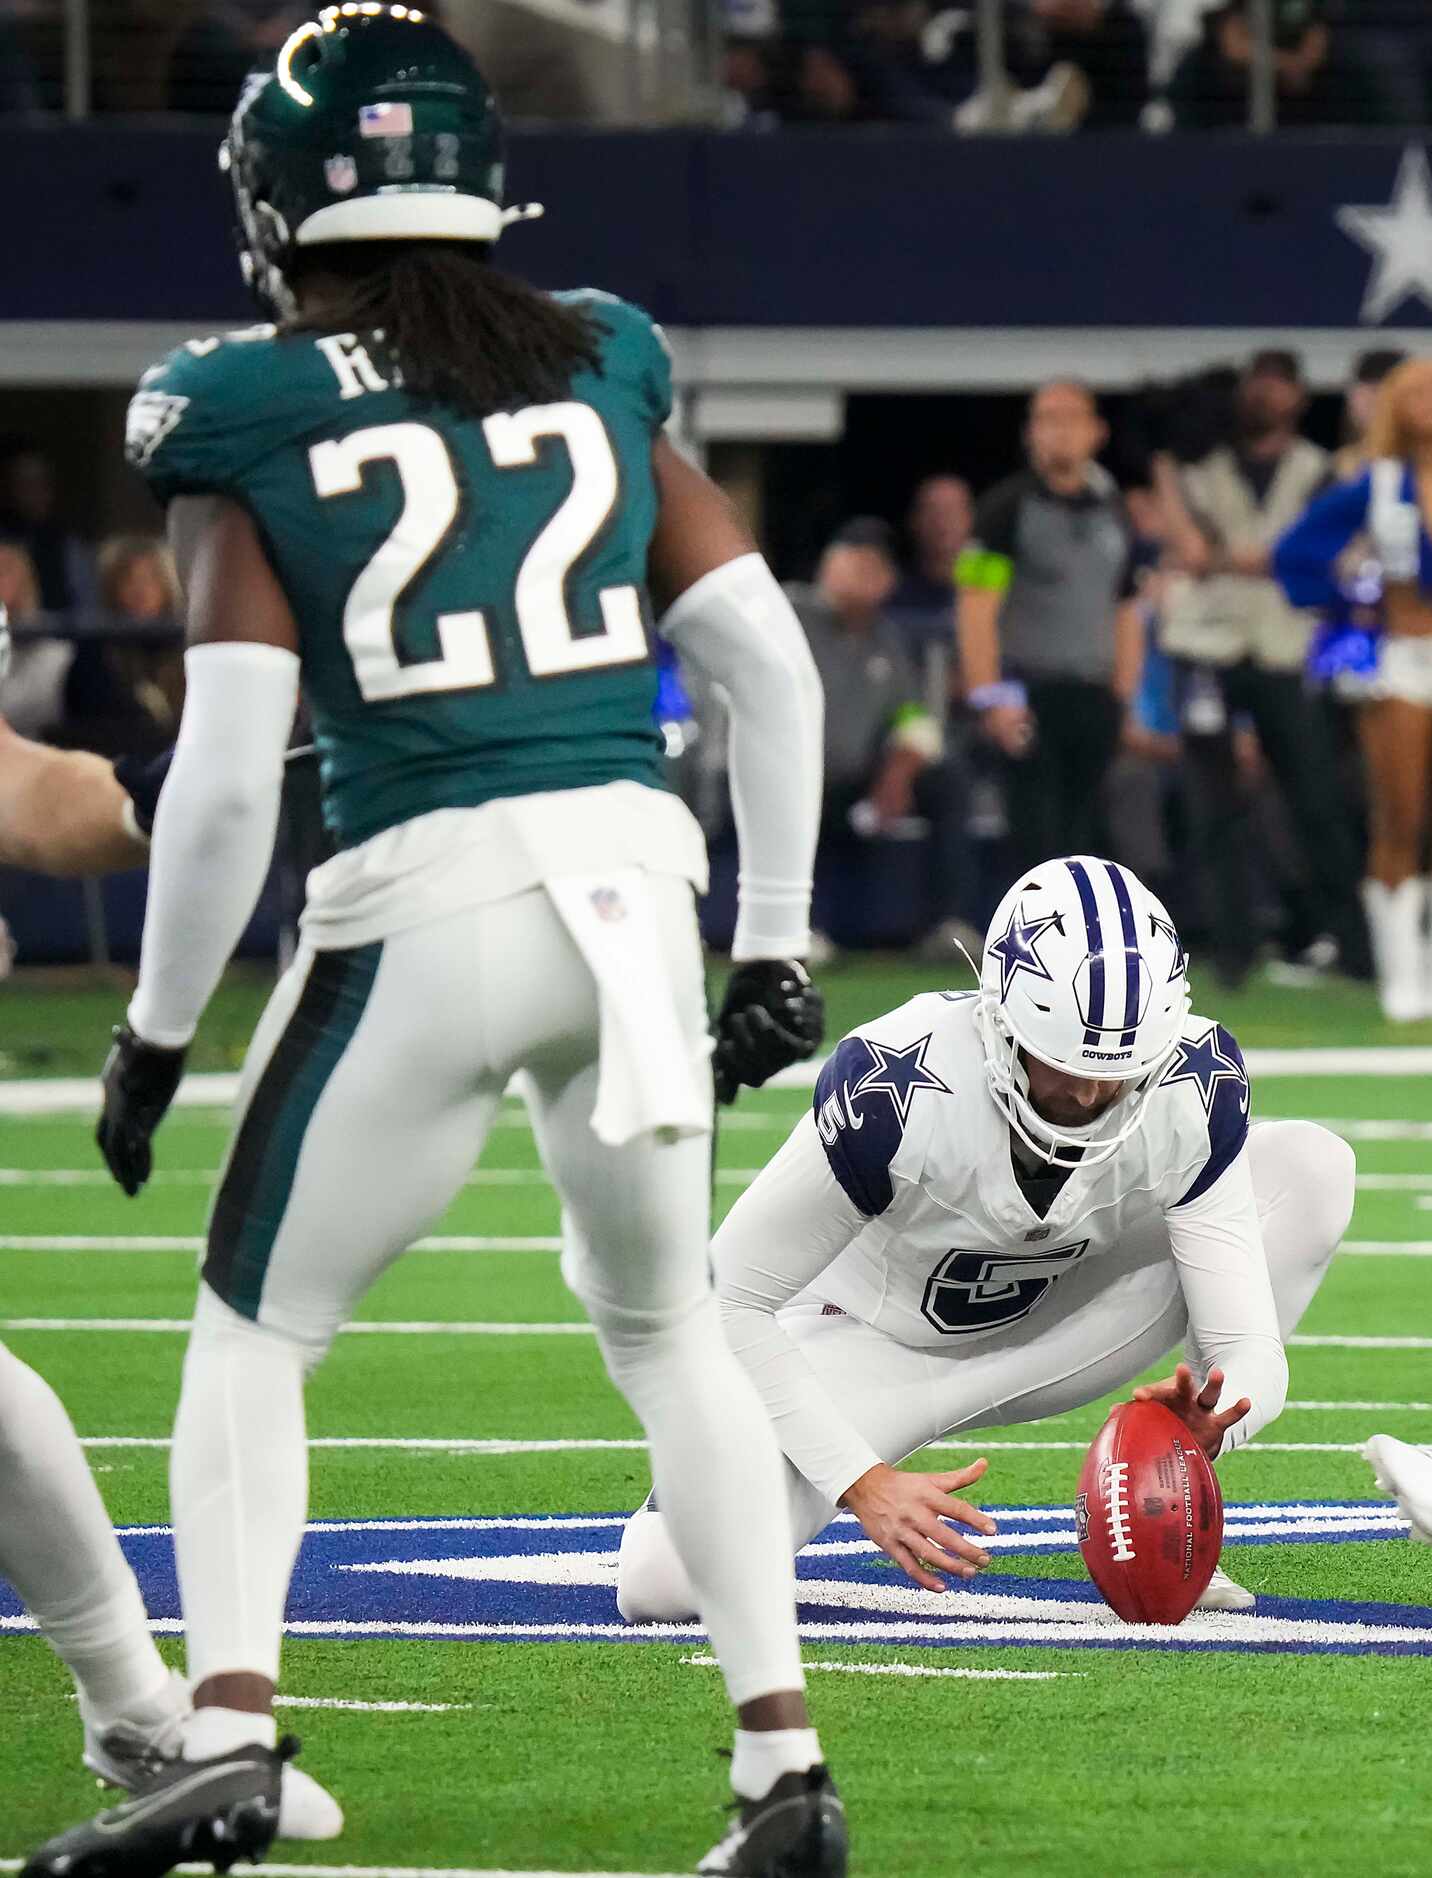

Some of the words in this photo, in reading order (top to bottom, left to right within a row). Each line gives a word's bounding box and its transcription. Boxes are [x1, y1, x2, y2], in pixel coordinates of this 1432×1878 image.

[308, 400, 649, 702] 22
[1082, 1049, 1133, 1061] COWBOYS
[818, 1089, 847, 1146] 5
[920, 1238, 1090, 1335] 5
[1173, 1439, 1188, 1473] LEAGUE
[1182, 1475, 1193, 1528] FOOTBALL
[1183, 1531, 1194, 1581] NATIONAL
